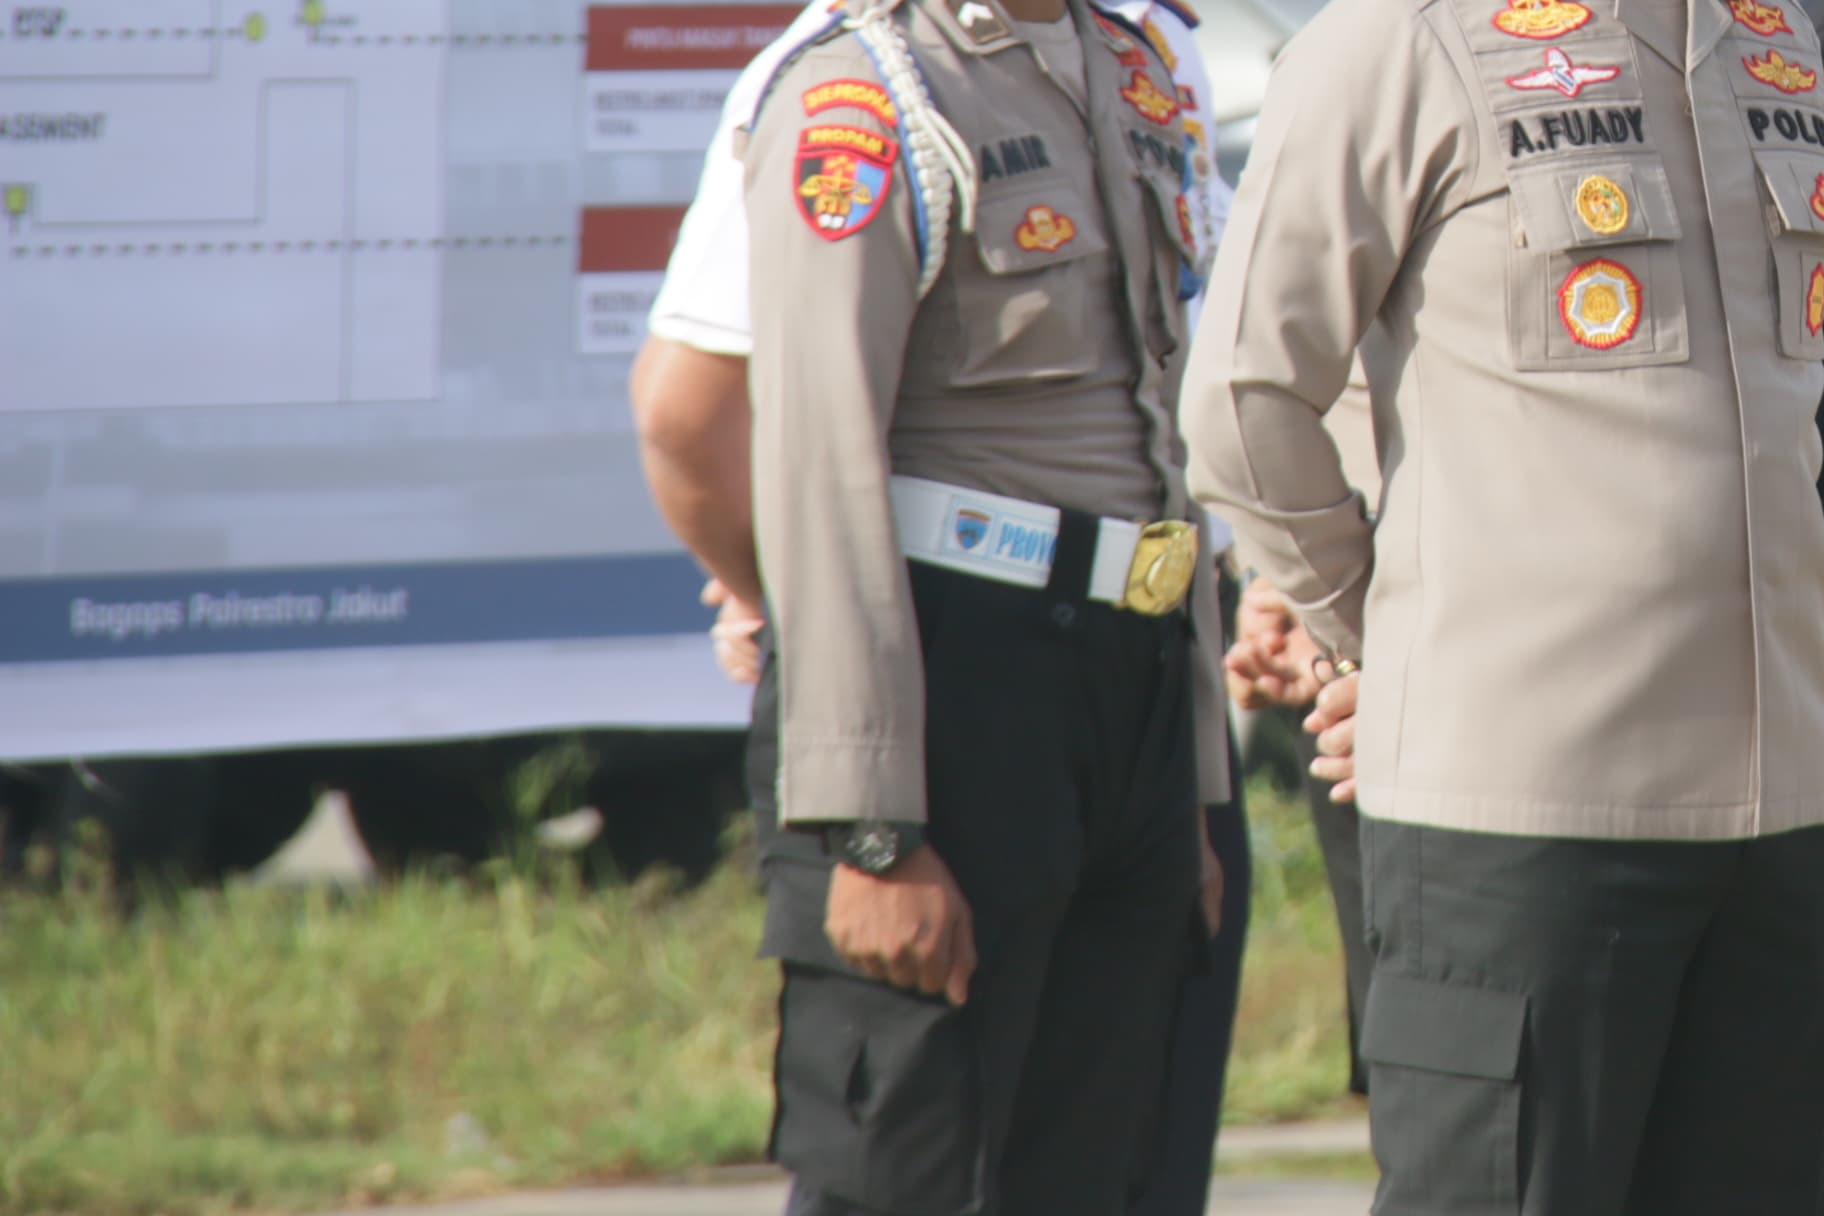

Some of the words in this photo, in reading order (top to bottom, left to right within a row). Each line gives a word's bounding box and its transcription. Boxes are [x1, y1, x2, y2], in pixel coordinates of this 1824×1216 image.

[808, 128, 883, 155] PROPAM
[1510, 106, 1644, 157] A.FUADY
[980, 134, 1051, 183] AMIR
